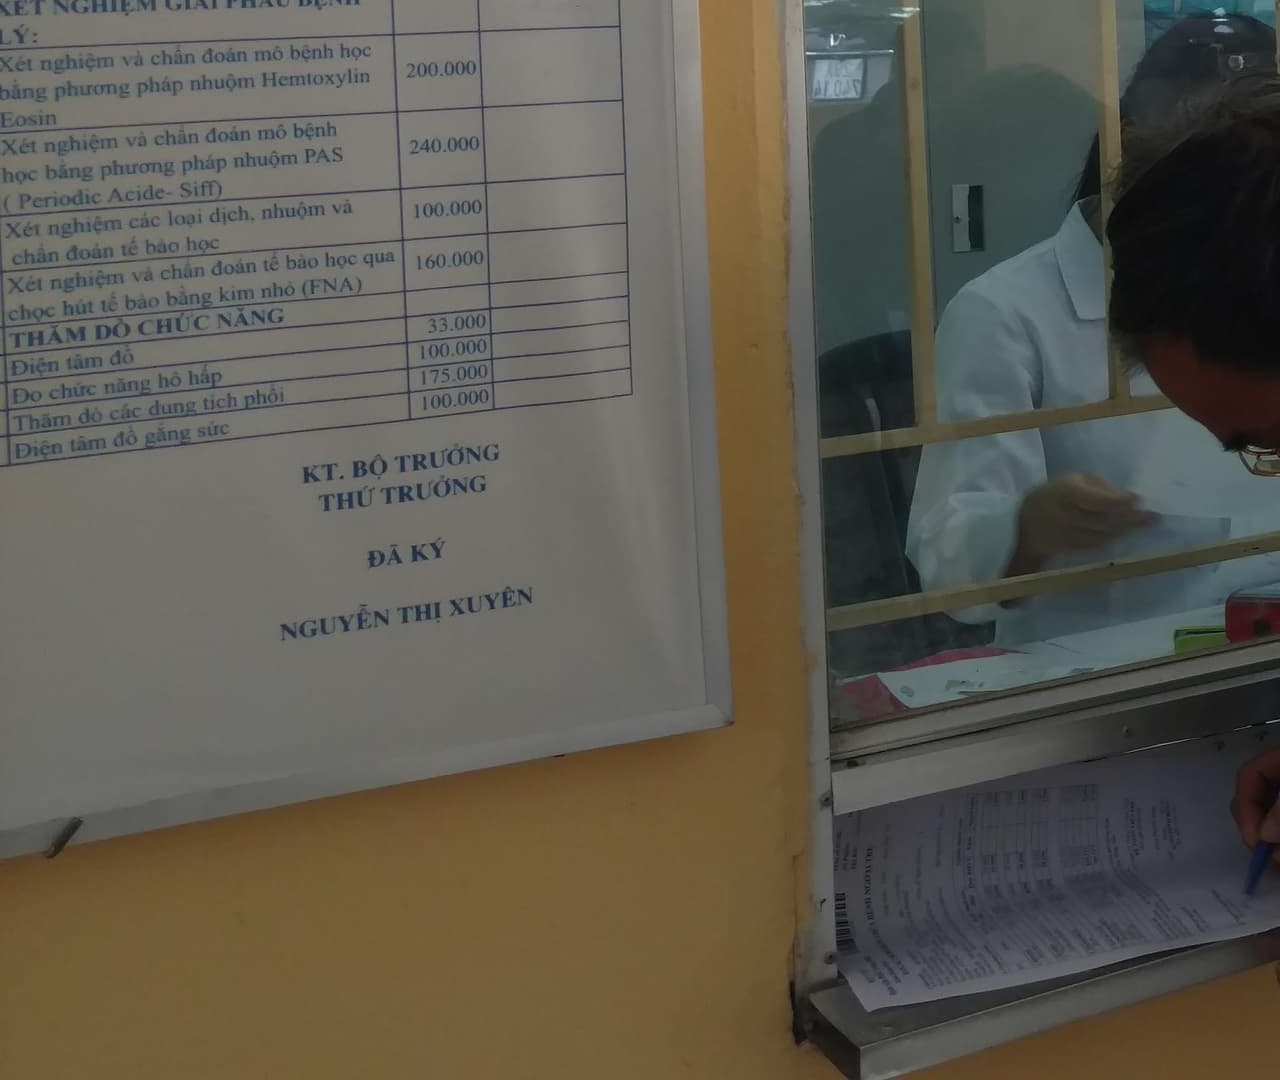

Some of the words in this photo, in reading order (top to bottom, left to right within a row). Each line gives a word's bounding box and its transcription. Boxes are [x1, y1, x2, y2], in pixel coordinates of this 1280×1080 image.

[405, 59, 478, 79] 200.000
[409, 135, 481, 156] 240.000
[413, 199, 483, 219] 100.000
[416, 249, 485, 271] 160.000
[8, 324, 87, 349] THĂM
[137, 312, 209, 336] CHỨC
[217, 307, 285, 329] NĂNG
[427, 313, 487, 334] 33.000
[420, 338, 488, 360] 100.000
[66, 353, 103, 370] tâm
[421, 363, 489, 386] 175.000
[422, 388, 490, 412] 100.000
[301, 462, 345, 485] KT.
[351, 453, 388, 480] BỘ
[393, 442, 500, 473] TRƯỞNG
[317, 485, 376, 513] THỨ
[379, 474, 487, 505] TRƯỞNG
[367, 543, 404, 569] ĐÃ
[410, 536, 447, 563] KÝ
[279, 603, 390, 642] NGUYỄN
[395, 601, 442, 625] THỊ
[449, 585, 533, 617] XUYÊN
